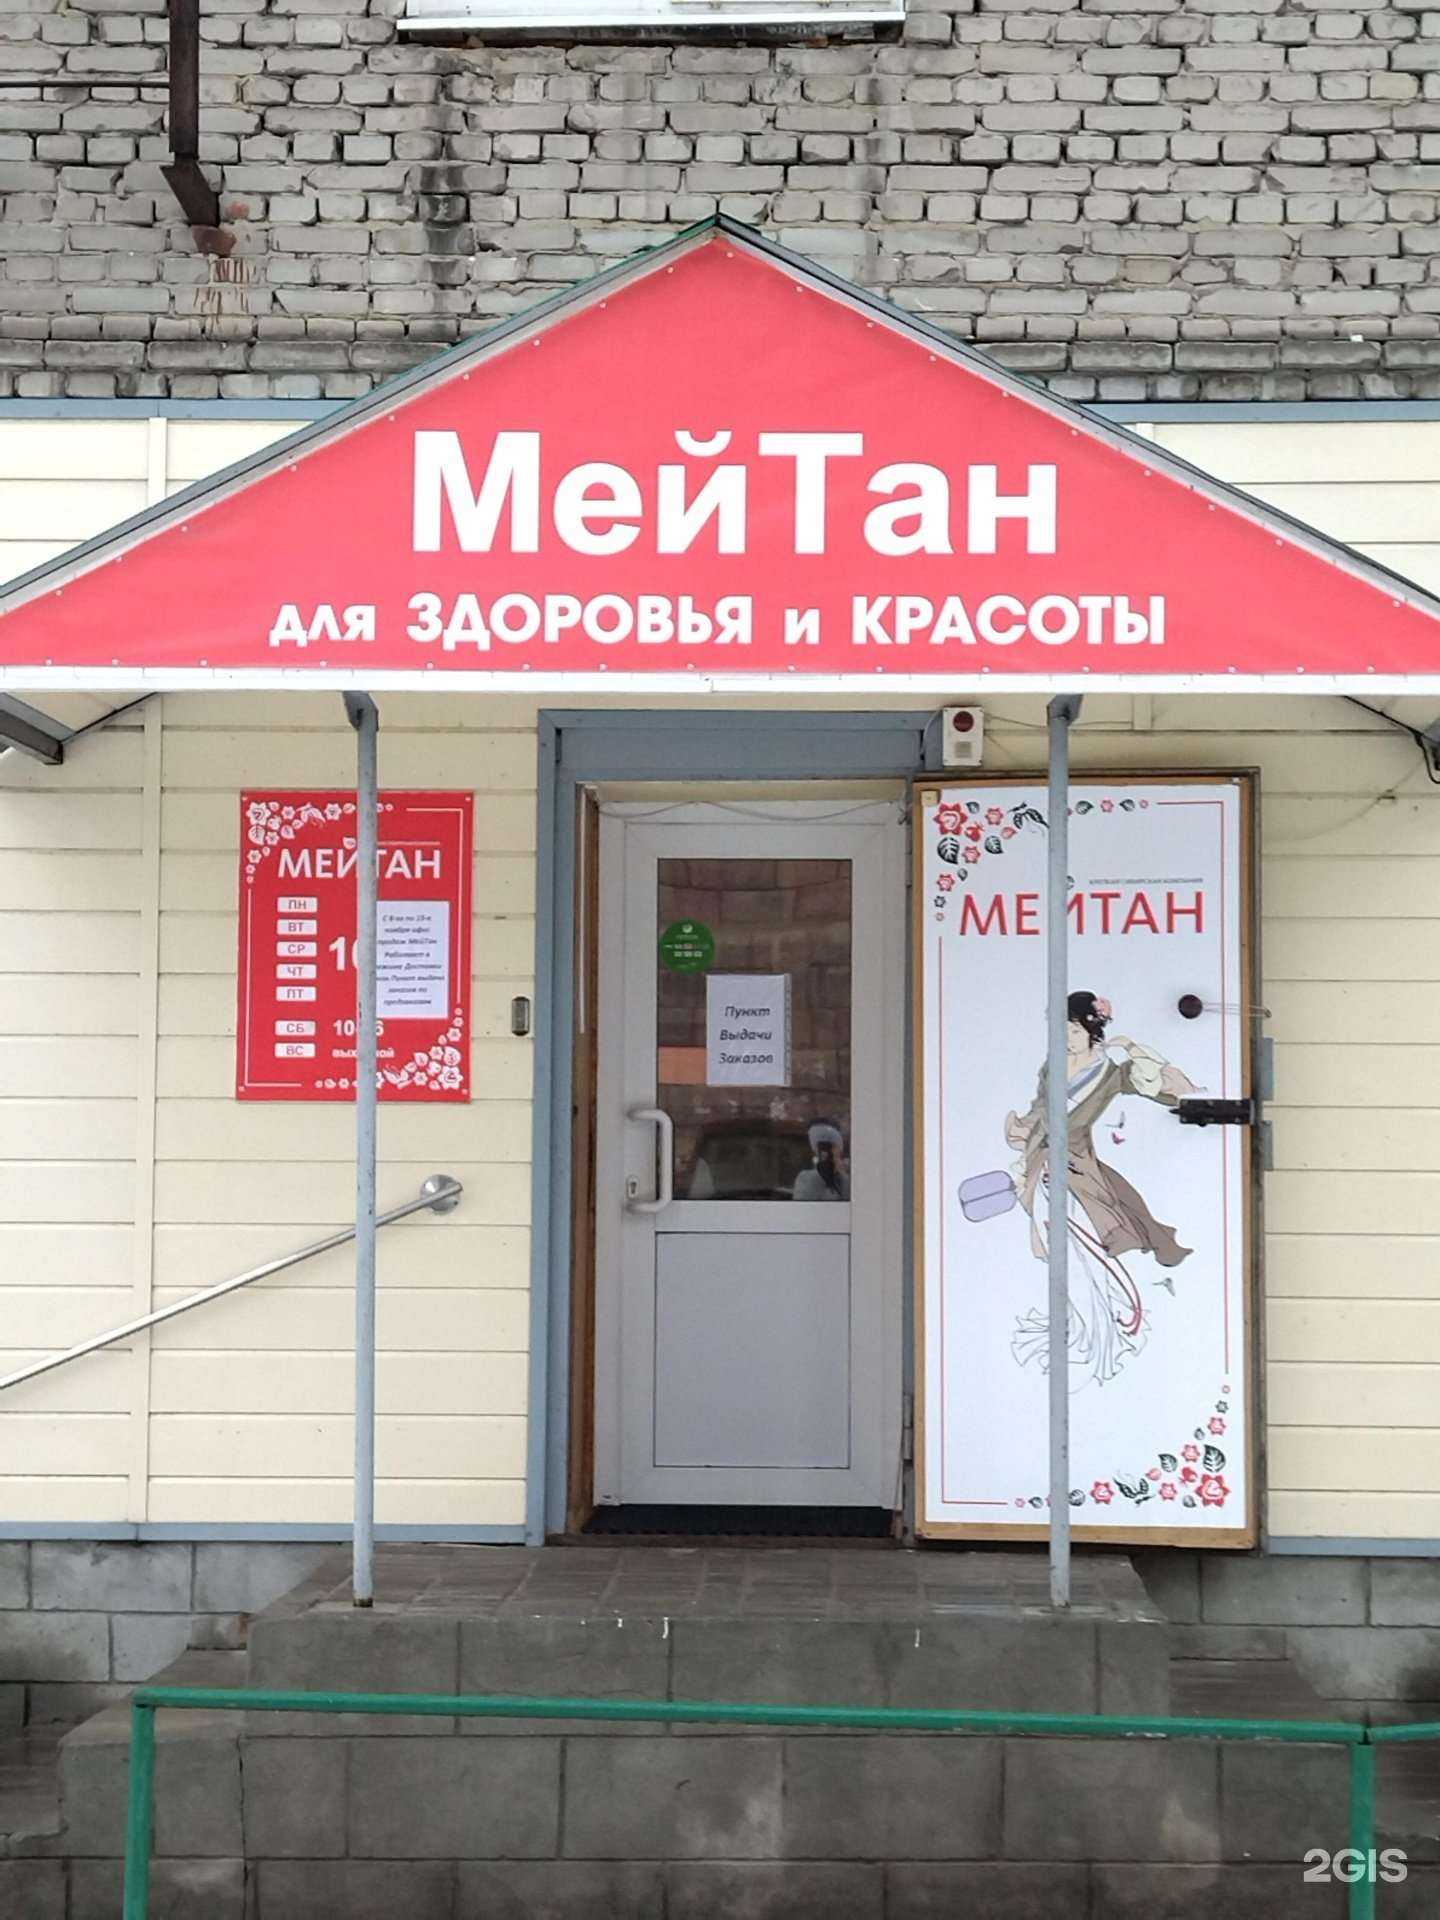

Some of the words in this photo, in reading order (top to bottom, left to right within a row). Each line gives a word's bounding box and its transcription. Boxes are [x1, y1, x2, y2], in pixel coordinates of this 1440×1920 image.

[414, 431, 1056, 555] МейТан
[271, 605, 374, 646] для
[408, 593, 751, 650] ЗДОРОВЬЯ
[786, 610, 819, 643] и
[854, 596, 1164, 644] КРАСОТЫ
[288, 899, 307, 910] ПН
[288, 922, 304, 932] ВТ
[287, 944, 306, 954] СР
[287, 967, 304, 977] ЧТ
[286, 989, 304, 999] ПТ
[724, 1005, 771, 1020] Пункт
[286, 1023, 305, 1034] СБ
[333, 1019, 385, 1036] 106
[719, 1028, 773, 1041] Выдачи
[286, 1045, 304, 1056] ВС
[331, 1047, 396, 1059] выхой
[718, 1052, 774, 1064] Заказов
